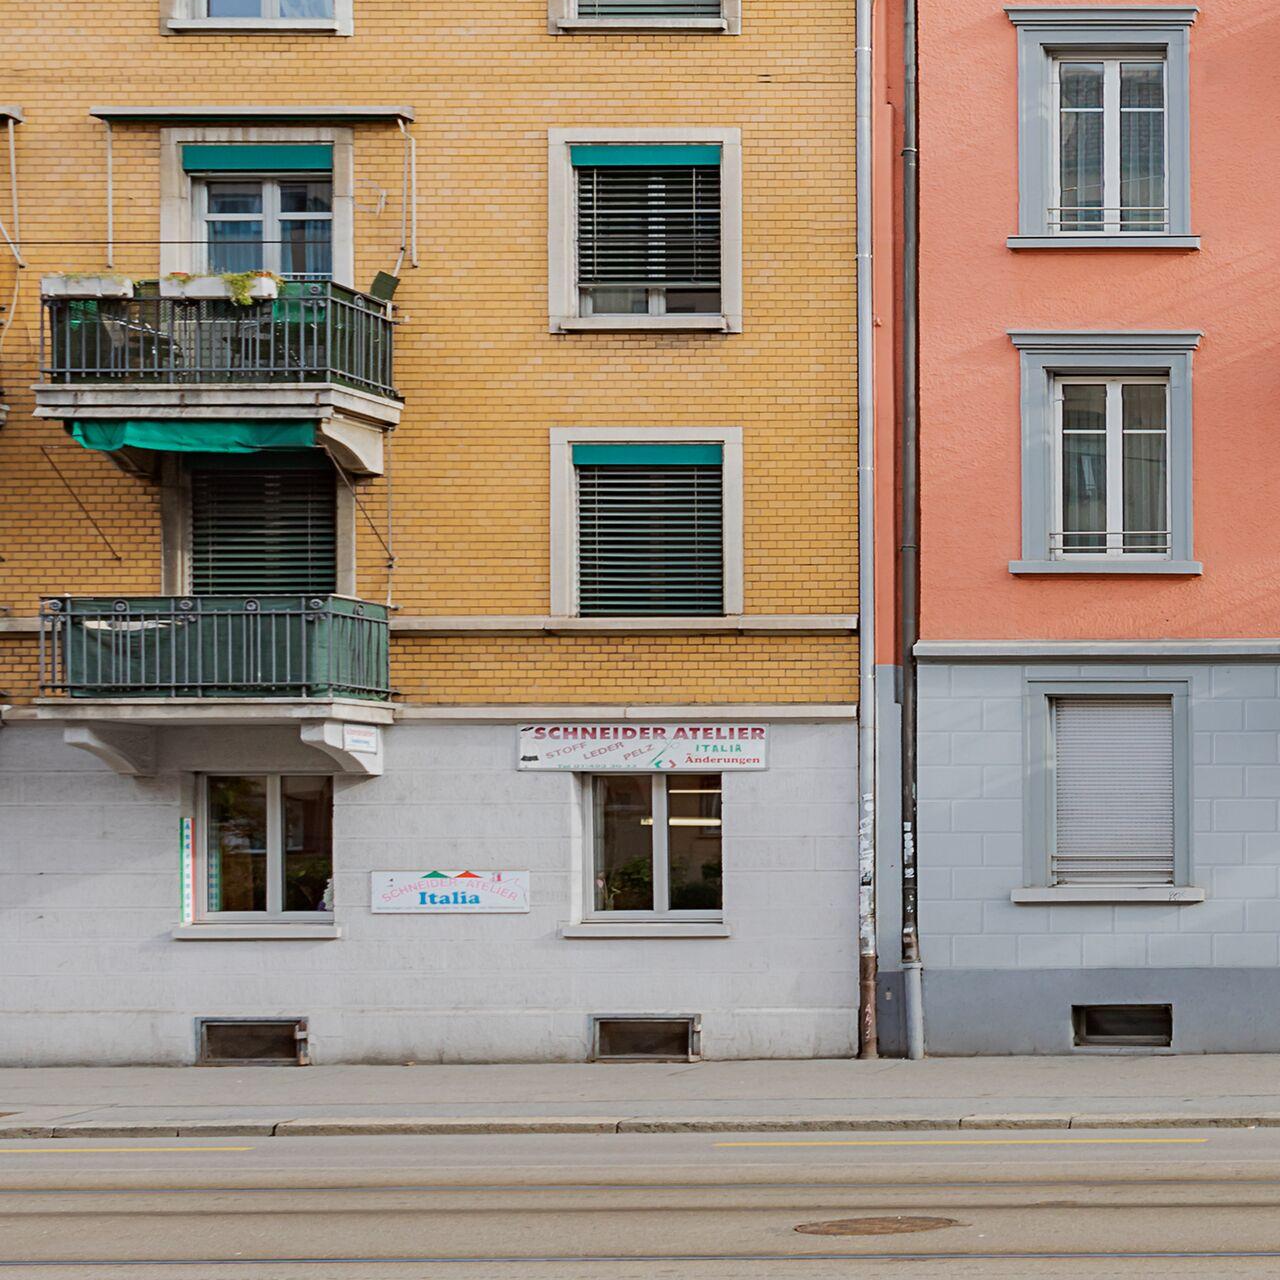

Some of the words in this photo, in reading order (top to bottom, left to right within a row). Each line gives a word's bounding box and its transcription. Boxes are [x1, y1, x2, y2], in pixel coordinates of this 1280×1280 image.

[533, 726, 667, 740] SCHNEIDER
[672, 726, 766, 740] ATELIER
[546, 741, 587, 759] STOFF
[583, 741, 625, 760] LEDER
[623, 743, 655, 760] PELZ
[696, 744, 742, 752] ITALIA
[685, 752, 760, 764] Änderungen
[418, 891, 480, 905] Italia
